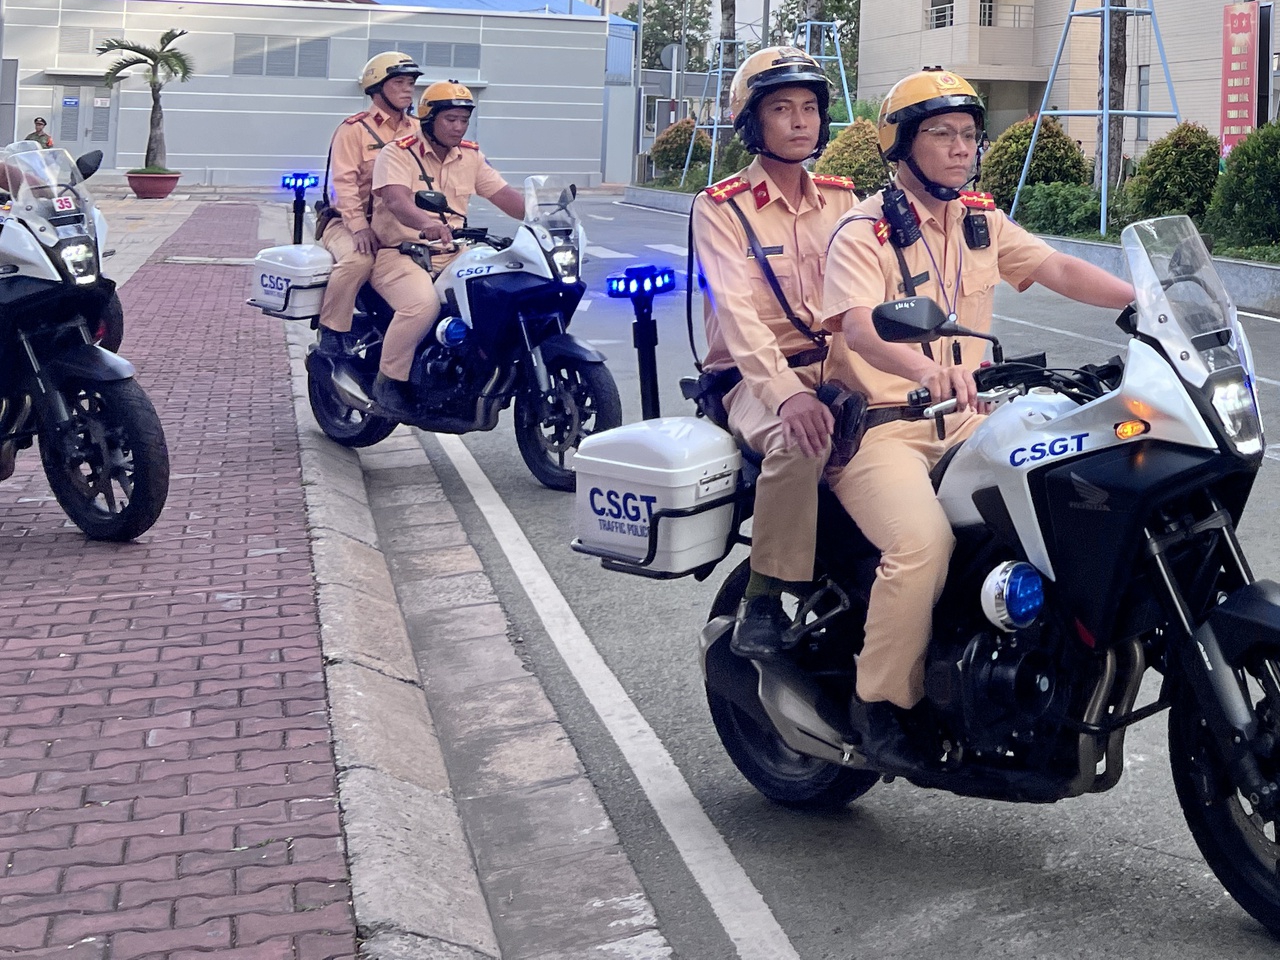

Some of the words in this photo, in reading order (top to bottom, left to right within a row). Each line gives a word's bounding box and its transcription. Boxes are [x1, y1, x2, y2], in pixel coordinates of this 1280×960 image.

[56, 198, 73, 210] 35
[1009, 432, 1090, 467] C.S.G.T
[598, 519, 627, 535] TRAFFIC
